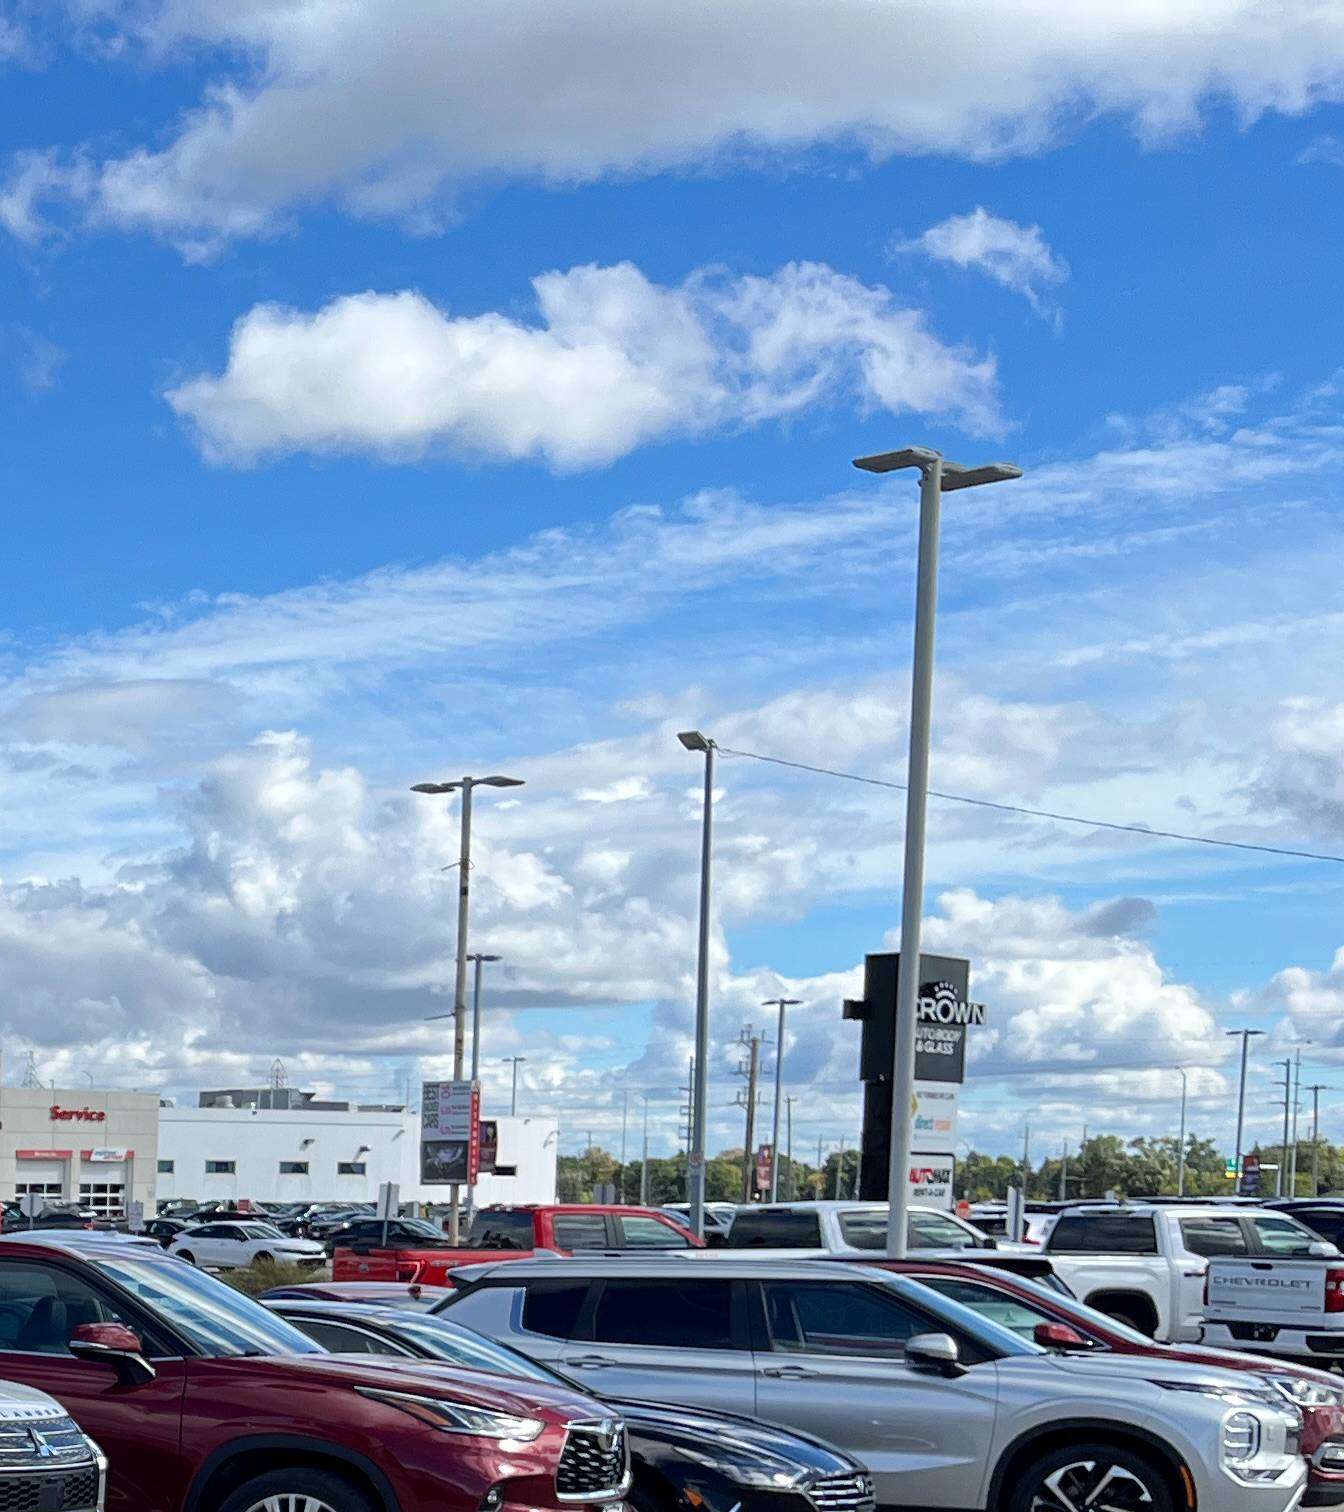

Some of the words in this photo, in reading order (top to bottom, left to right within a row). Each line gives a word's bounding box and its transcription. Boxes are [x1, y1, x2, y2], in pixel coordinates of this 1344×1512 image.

[916, 1026, 962, 1042] UTOBODY
[50, 1105, 105, 1121] Service
[1213, 1276, 1312, 1289] CHEVROLET
